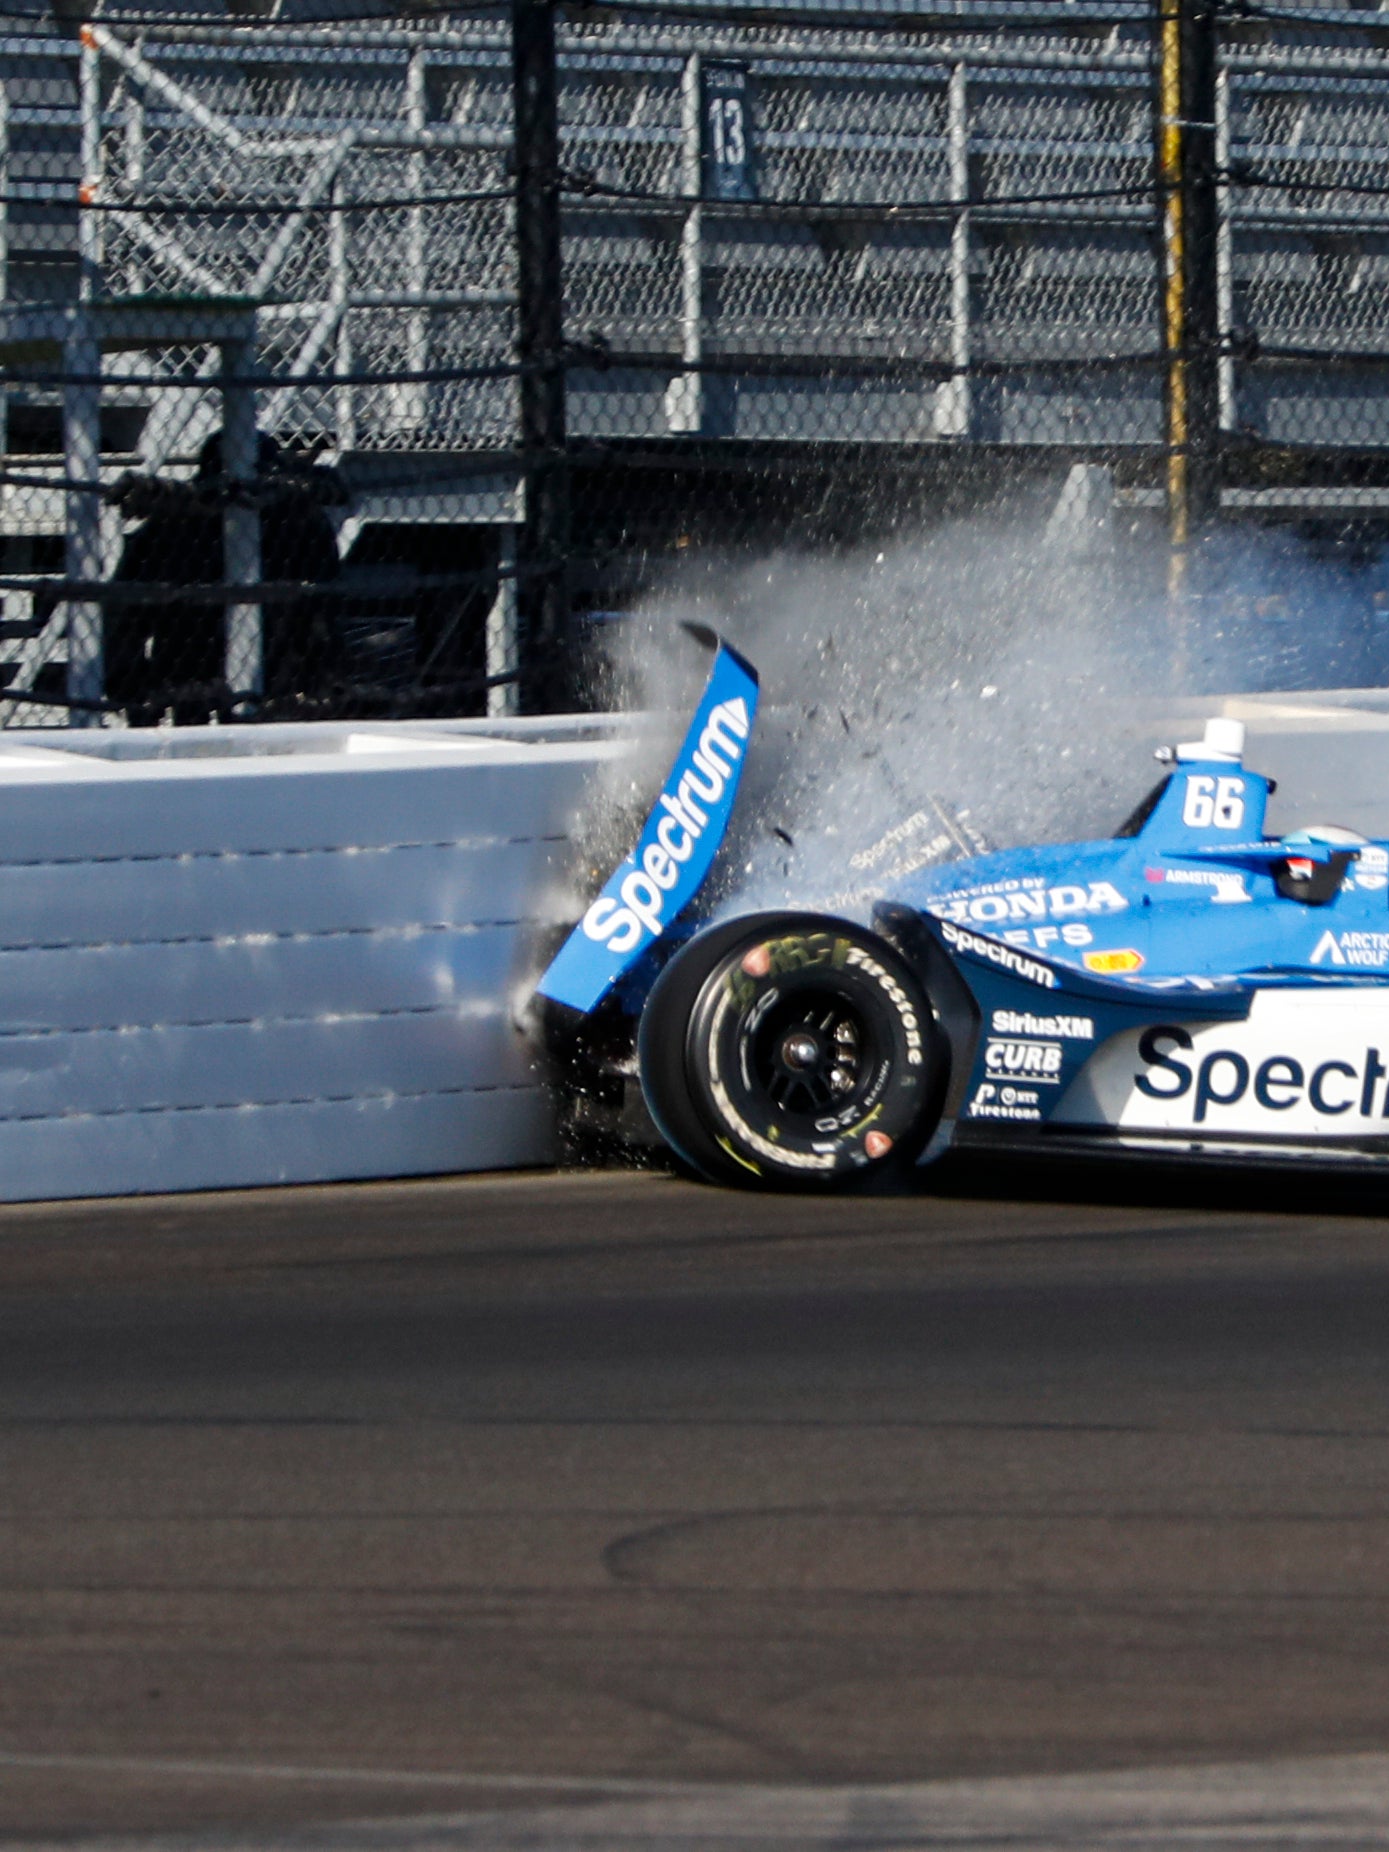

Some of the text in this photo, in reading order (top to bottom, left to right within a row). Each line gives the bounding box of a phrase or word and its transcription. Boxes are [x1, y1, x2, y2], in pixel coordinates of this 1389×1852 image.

[708, 98, 745, 165] 13
[582, 702, 749, 954] Spectrum
[1183, 775, 1245, 829] 66
[926, 881, 1130, 923] HONDA
[941, 921, 1057, 989] Spectrum
[846, 947, 923, 1066] Firestone
[992, 1010, 1094, 1039] SiriusXM
[985, 1043, 1062, 1072] CURB
